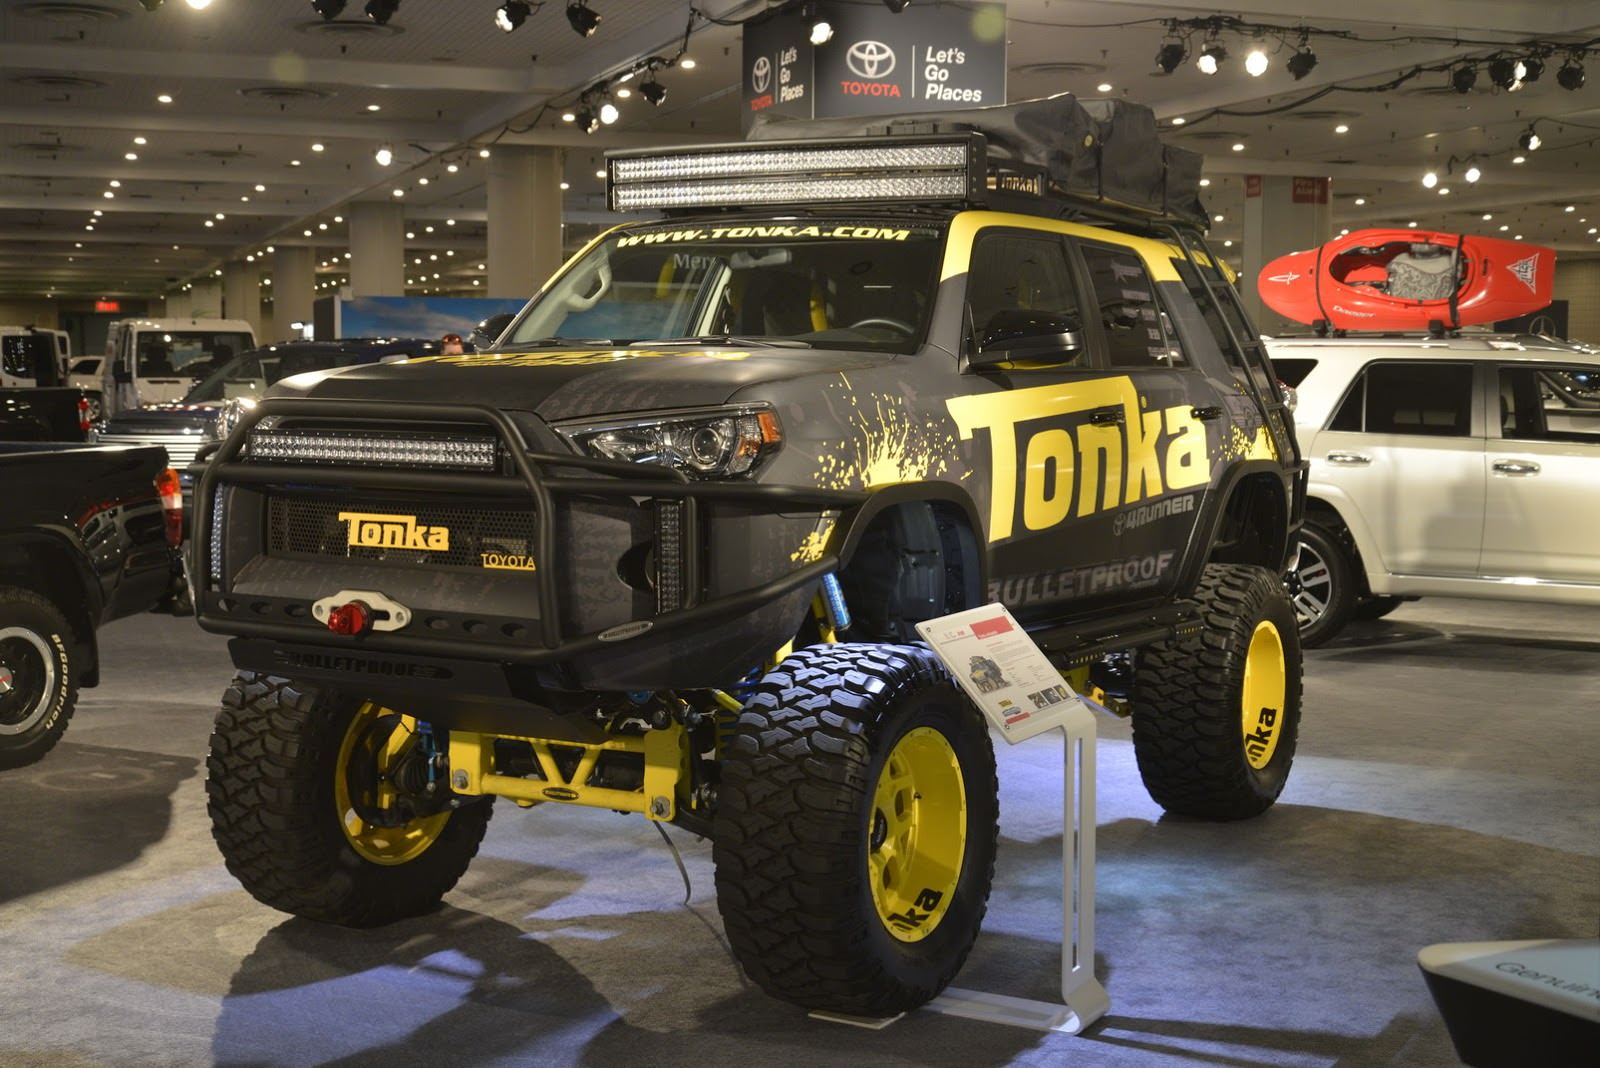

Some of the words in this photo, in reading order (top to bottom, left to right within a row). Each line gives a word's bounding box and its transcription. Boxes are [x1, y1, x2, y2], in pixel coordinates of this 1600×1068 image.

[780, 46, 798, 67] Let's
[925, 46, 966, 65] Let's
[780, 67, 791, 85] Go
[925, 65, 950, 82] Go
[780, 83, 804, 104] Places
[841, 81, 901, 98] TOYOTA
[925, 83, 983, 103] Places
[616, 226, 910, 248] WWW.TONKA.COM
[945, 375, 1212, 543] Tonka
[1126, 494, 1195, 529] 4RUNNER
[339, 511, 449, 551] Tonka
[480, 552, 537, 571] TOYOTA
[1245, 707, 1277, 762] nka
